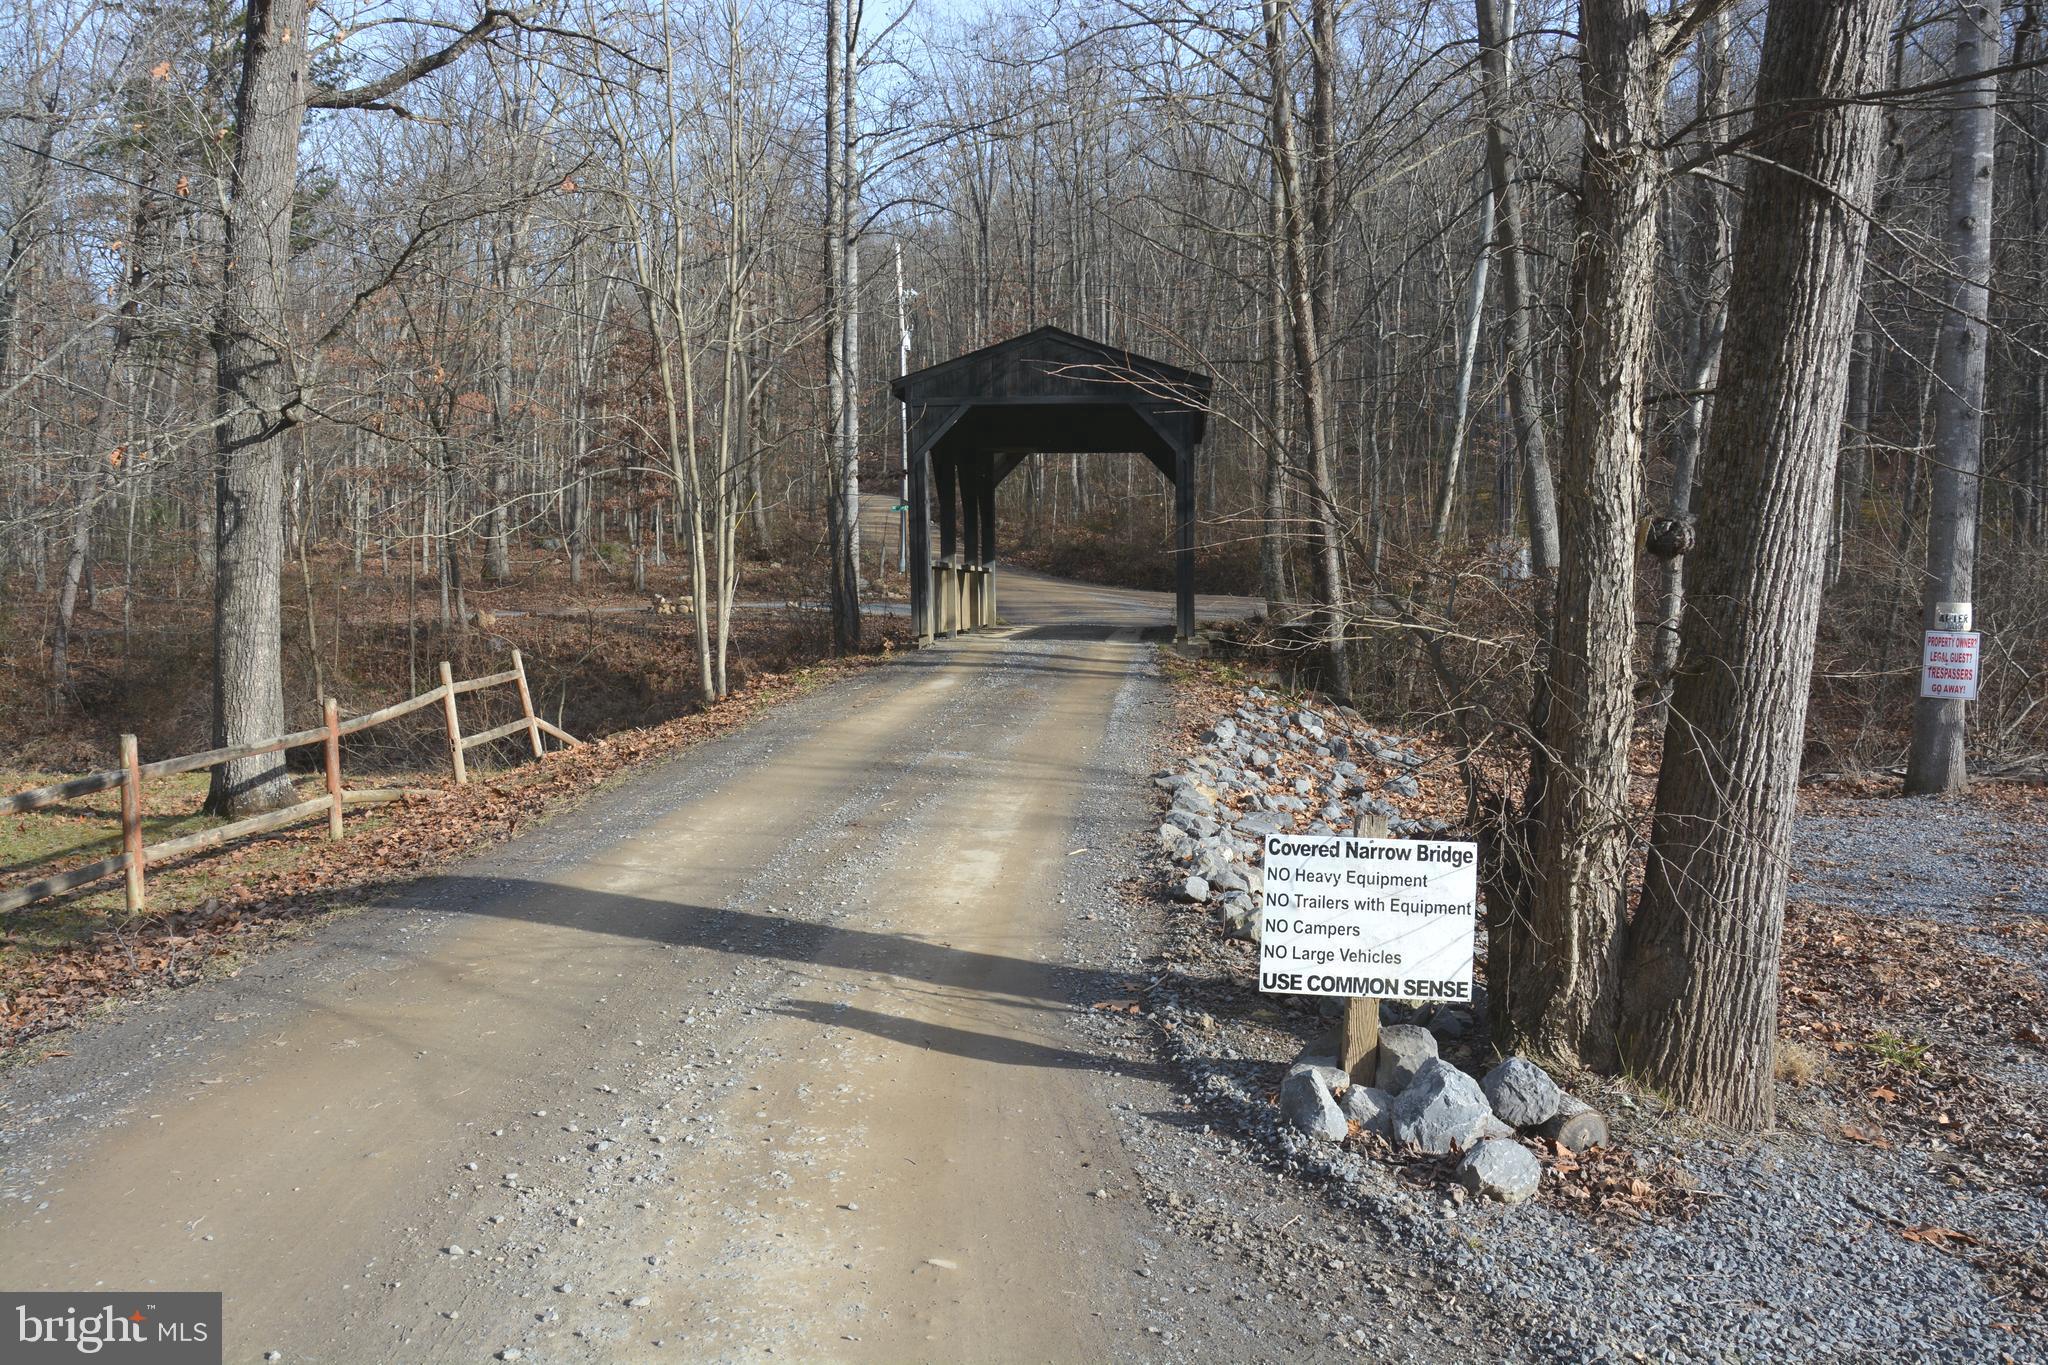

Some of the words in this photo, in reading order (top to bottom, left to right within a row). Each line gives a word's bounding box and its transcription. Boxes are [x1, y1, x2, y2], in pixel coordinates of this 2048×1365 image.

[1928, 636, 1954, 647] PROPERTY
[1956, 638, 1977, 648] OWNER?
[1930, 651, 1948, 662] LEGAL
[1951, 652, 1972, 663] GUEST?
[1928, 666, 1973, 680] TRESPASSERS
[1932, 684, 1942, 692] GO
[1944, 685, 1966, 693] AWAY!
[1268, 838, 1340, 858] Covered
[1346, 842, 1411, 861] Narrow
[1417, 844, 1473, 867] Bridge
[1267, 867, 1290, 881] NO
[1295, 869, 1341, 887] Heavy
[1346, 871, 1427, 888] Equipment
[1266, 894, 1289, 907] NO
[1294, 894, 1349, 910] Trailers
[1354, 898, 1385, 911] with
[1390, 899, 1471, 916] Equipment
[1265, 919, 1288, 933] NO
[1293, 920, 1360, 938] Campers
[1264, 945, 1287, 959] NO
[1292, 946, 1334, 964] Large
[1340, 949, 1401, 964] Vehicles
[1263, 973, 1302, 990] USE
[1307, 975, 1398, 995] COMMON
[1404, 980, 1468, 998] SENSE
